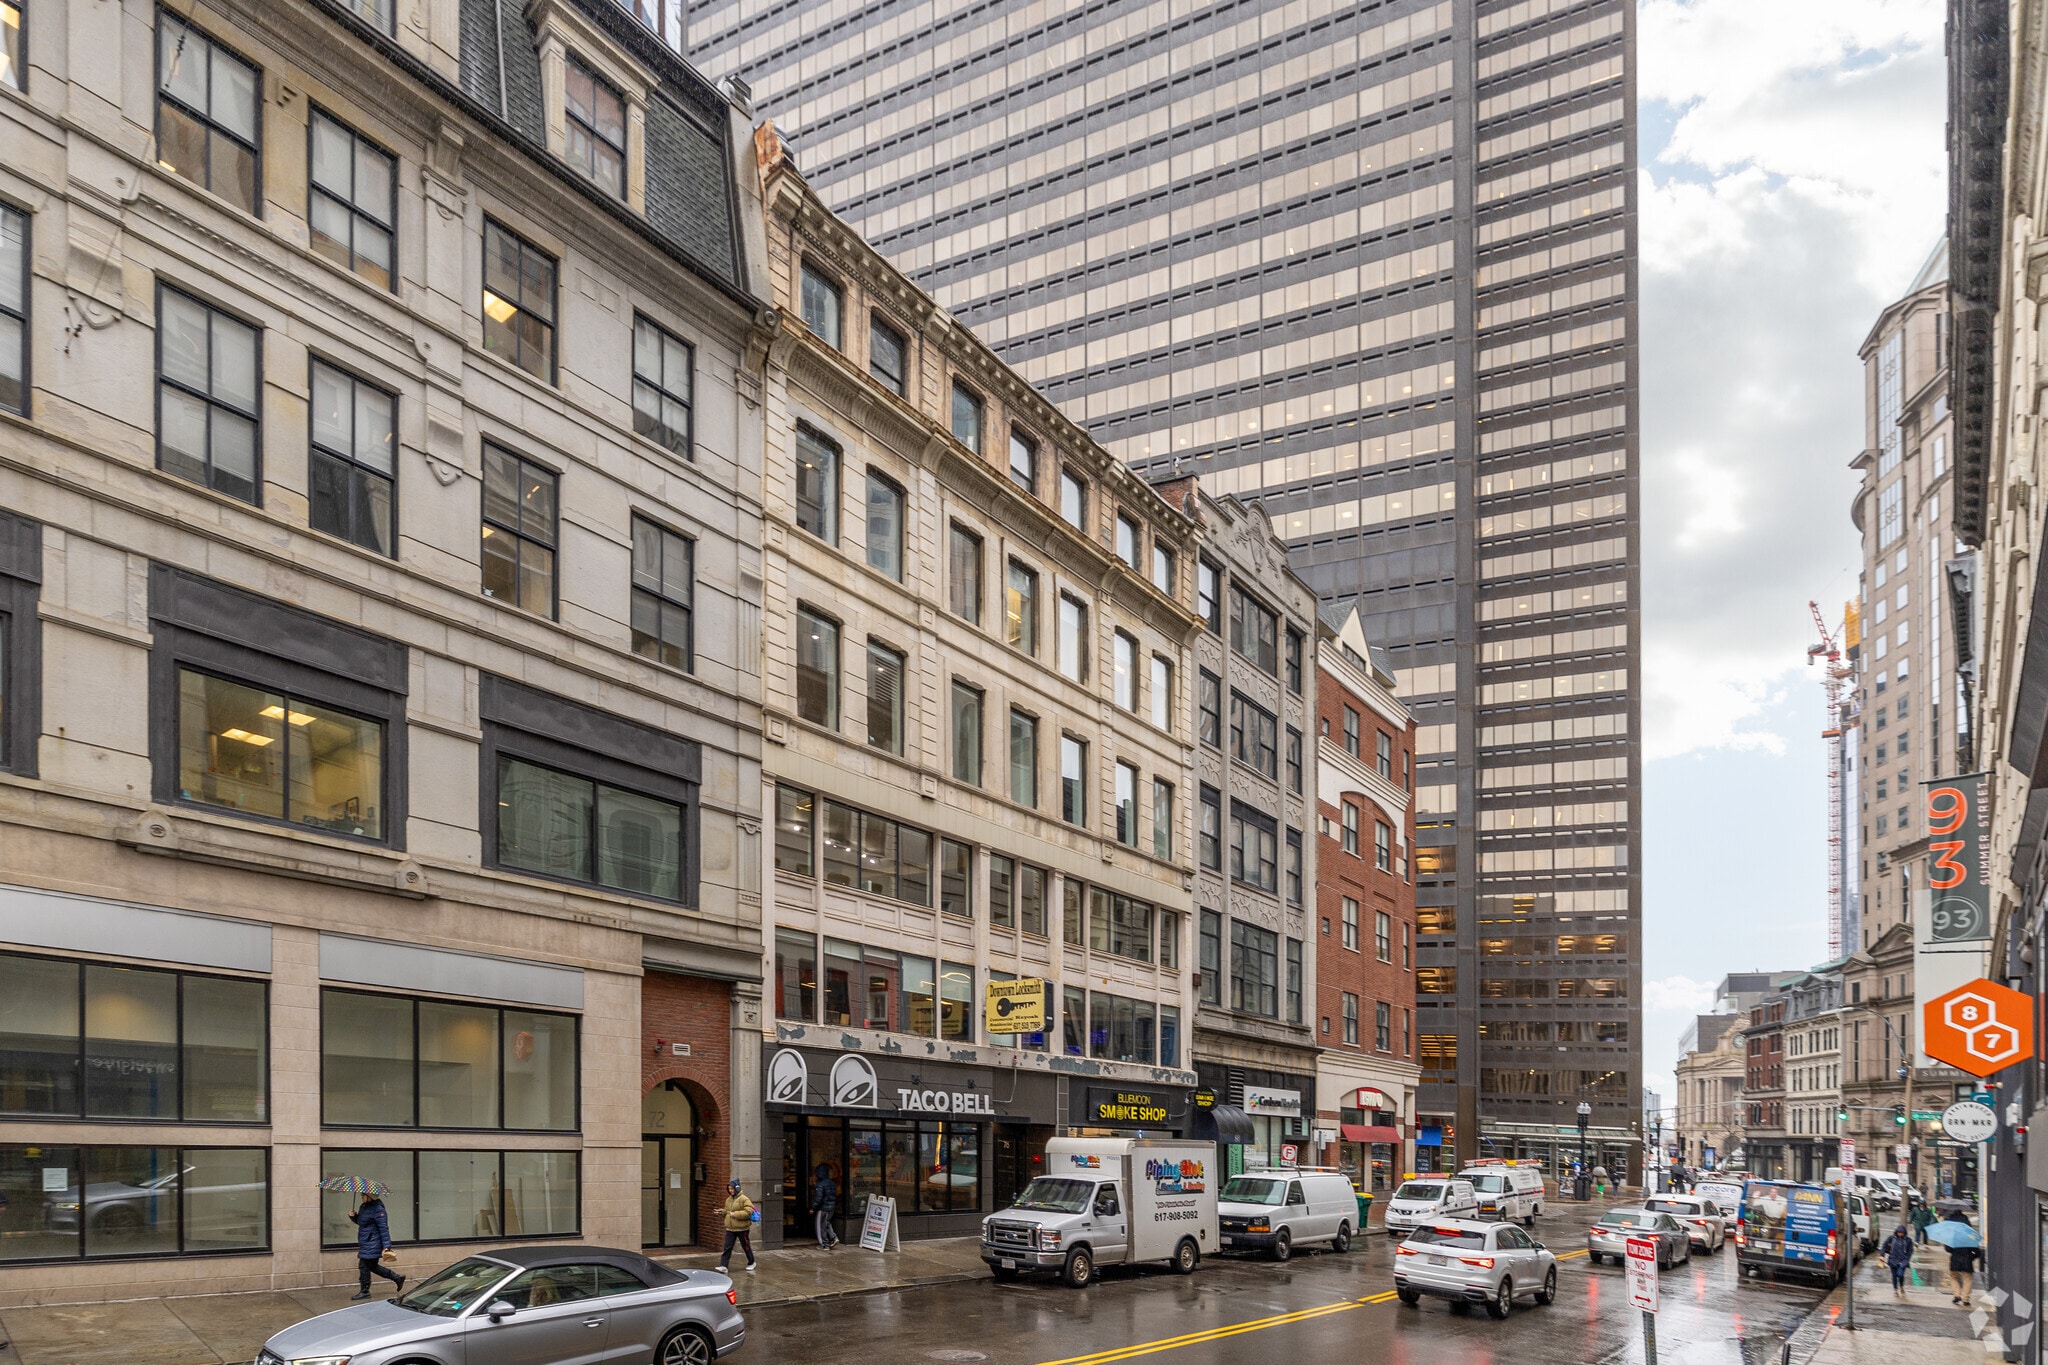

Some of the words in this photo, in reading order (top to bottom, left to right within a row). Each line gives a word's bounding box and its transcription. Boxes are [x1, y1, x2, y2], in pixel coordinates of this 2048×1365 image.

[1928, 787, 1968, 836] 9
[1976, 781, 1990, 828] STREET
[1929, 839, 1968, 890] 3
[1978, 833, 1991, 887] SUMMER
[1933, 908, 1972, 931] 93
[1961, 1005, 1979, 1021] 8
[1984, 1033, 2002, 1049] 7
[897, 1088, 950, 1112] TACO
[951, 1092, 995, 1114] BELL
[648, 1111, 665, 1128] 72
[1099, 1104, 1138, 1120] SMOKE
[1138, 1107, 1167, 1121] SHOP
[1285, 1148, 1293, 1158] F
[1145, 1158, 1181, 1182] Piping
[1180, 1159, 1204, 1179] Hot
[1702, 1185, 1737, 1193] encore
[1154, 1210, 1199, 1222] 617-908-5092
[1627, 1243, 1639, 1256] TOW
[1638, 1245, 1654, 1259] ZONE
[1634, 1260, 1647, 1271] NO
